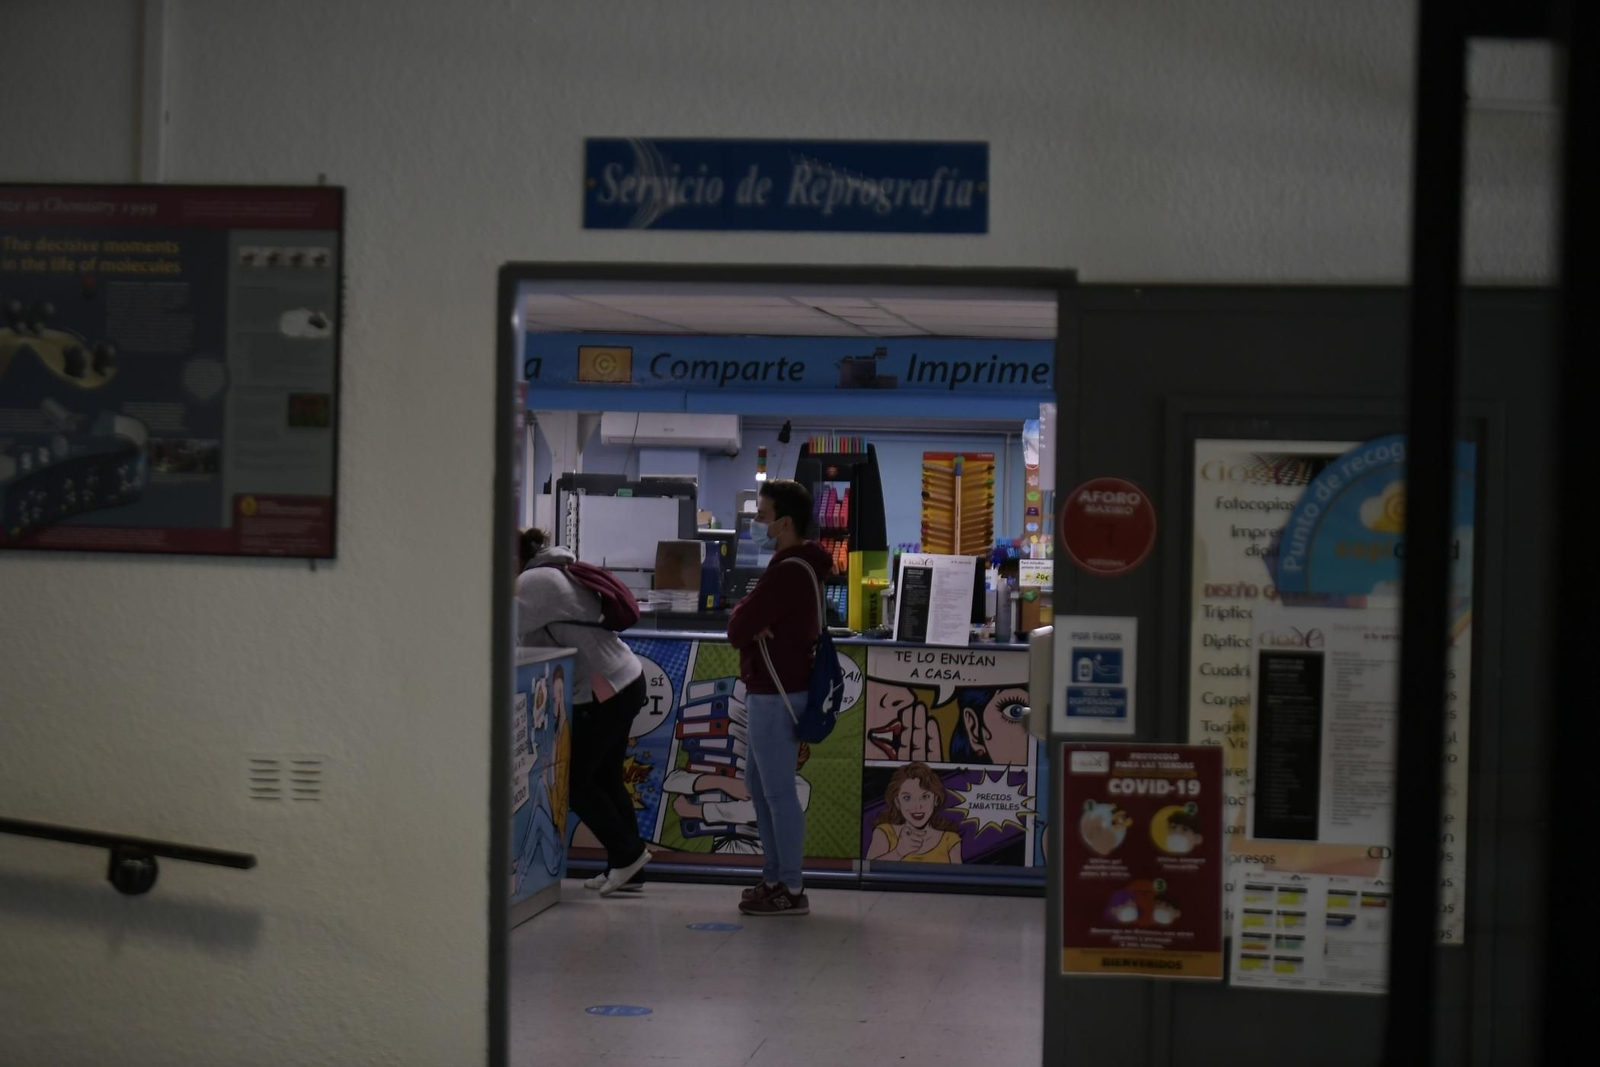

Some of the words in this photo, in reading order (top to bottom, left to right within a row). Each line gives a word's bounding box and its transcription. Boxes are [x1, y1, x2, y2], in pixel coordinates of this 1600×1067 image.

[597, 163, 724, 206] Servicio
[736, 165, 773, 206] de
[43, 196, 116, 218] Chemistry
[3, 235, 32, 251] The
[36, 236, 98, 253] decisive
[103, 240, 181, 255] moments
[21, 256, 47, 272] the
[50, 256, 77, 273] life
[79, 256, 98, 272] of
[100, 258, 183, 274] molecules
[524, 356, 543, 380] a
[650, 352, 806, 387] Comparte
[906, 353, 1050, 390] Imprime
[1077, 489, 1142, 505] AFORO
[1215, 495, 1296, 513] Fotocopias
[1283, 502, 1320, 572] Punto
[1315, 474, 1342, 502] de
[1342, 441, 1406, 477] recog
[1036, 573, 1050, 581] 20€
[1093, 632, 1123, 642] FAVOR
[894, 650, 912, 662] TE
[917, 652, 935, 664] LO
[940, 651, 996, 667] ENVÍAN
[910, 668, 920, 678] A
[925, 668, 977, 682] CASA...
[1199, 662, 1251, 677] Cuadri
[1108, 778, 1201, 796] COVID-19
[976, 793, 1012, 802] PRECIOS
[968, 802, 1020, 811] IMBATIBLES
